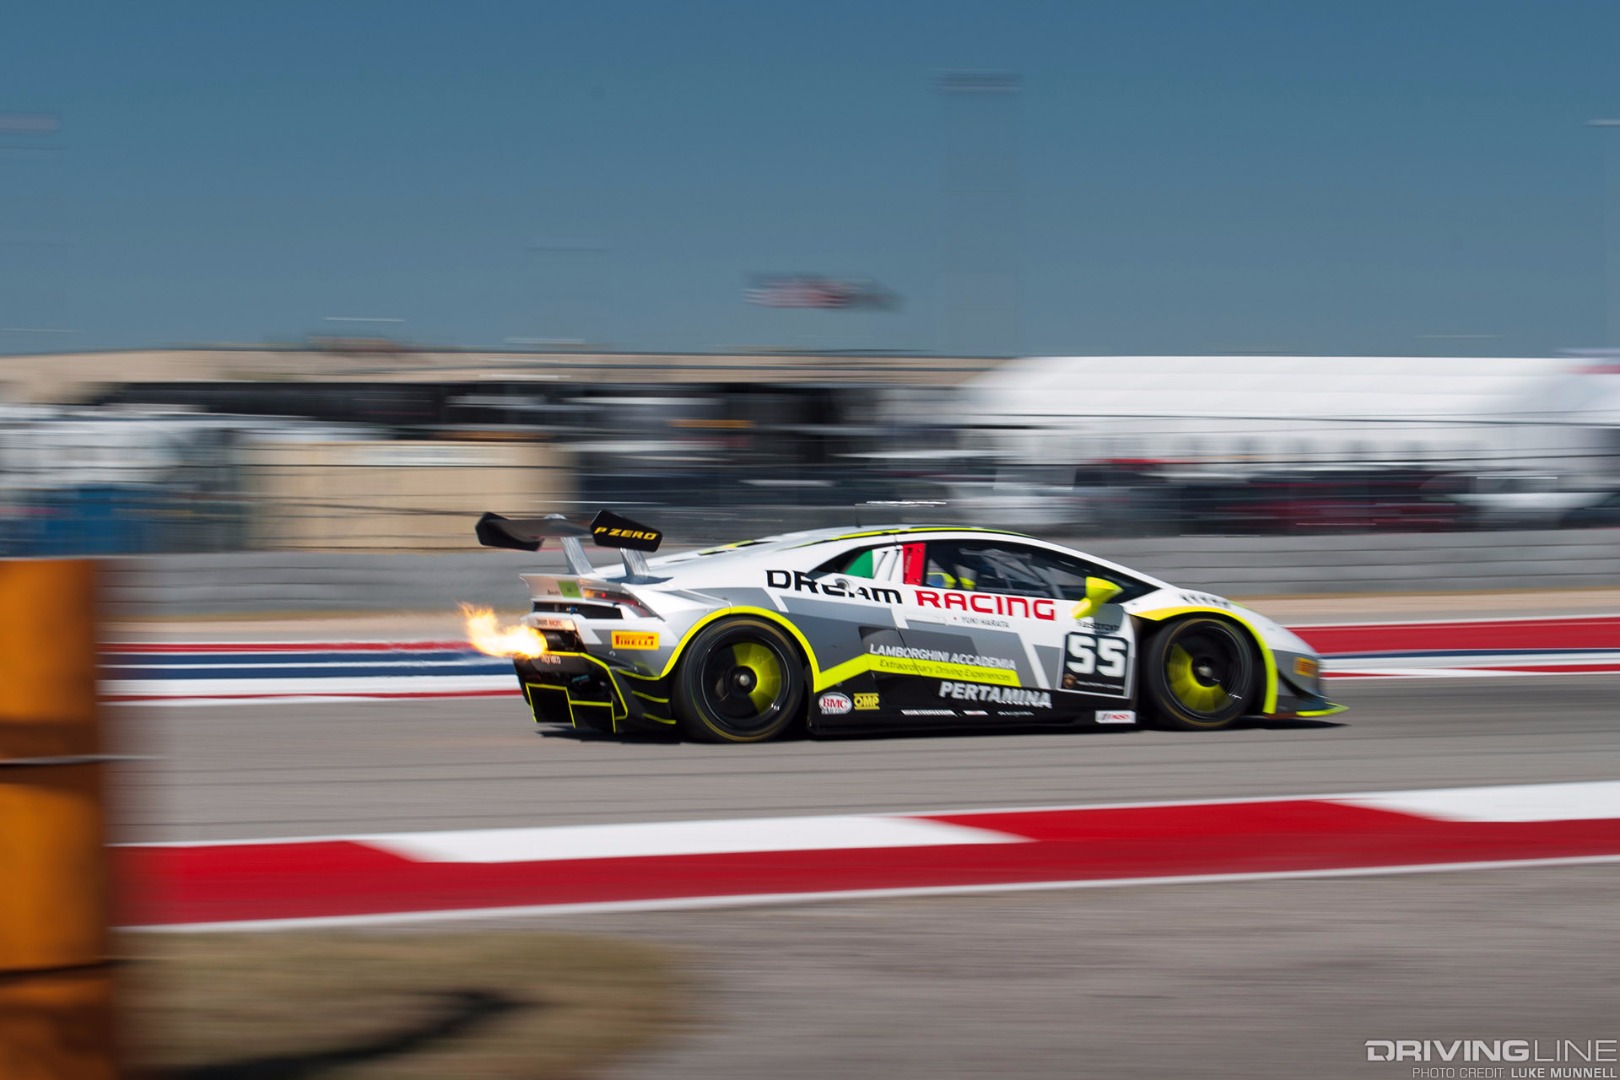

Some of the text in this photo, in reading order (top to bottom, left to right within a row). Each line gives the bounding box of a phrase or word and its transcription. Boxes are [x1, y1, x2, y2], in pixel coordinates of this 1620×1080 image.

[594, 526, 659, 541] P ZERO
[914, 589, 1057, 621] RACING
[615, 634, 655, 647] PIRELLI
[870, 643, 1017, 670] LAMBORGHINI ACCADEMIA
[1065, 633, 1127, 678] 55
[879, 659, 1012, 682] Extraordinary Driving Experiences
[853, 693, 880, 710] OMP
[938, 681, 1053, 709] PERTAMINA
